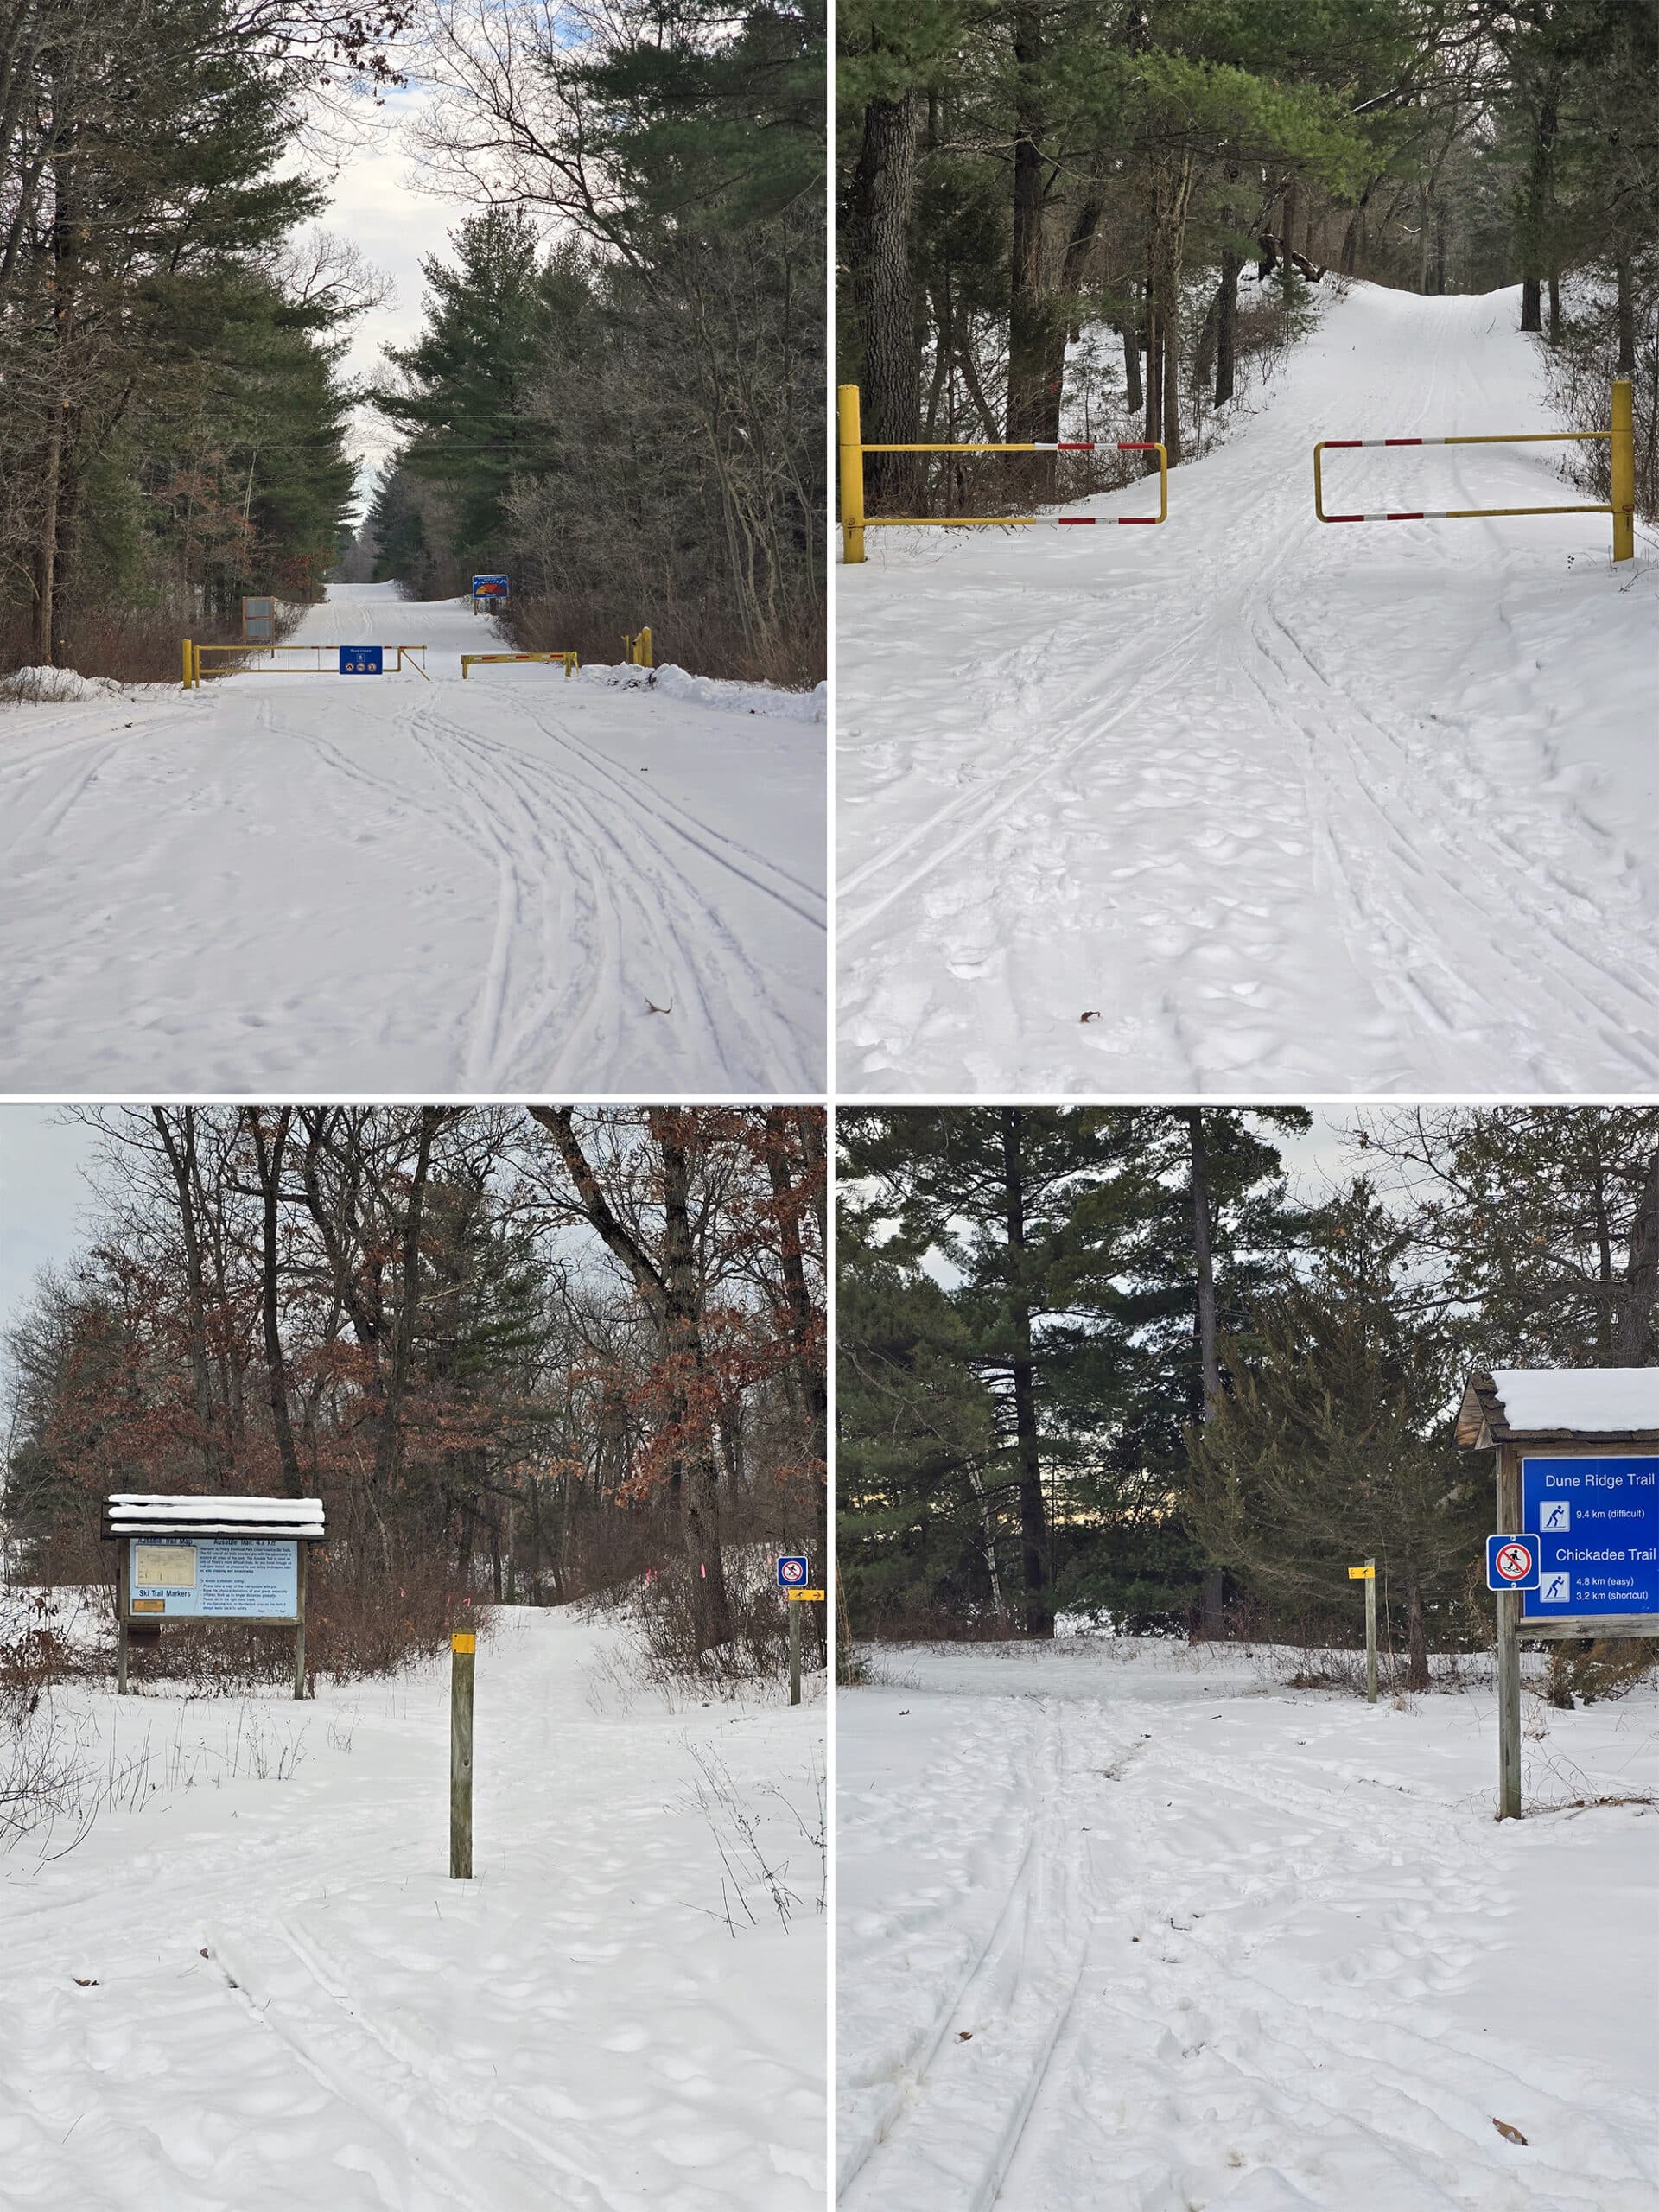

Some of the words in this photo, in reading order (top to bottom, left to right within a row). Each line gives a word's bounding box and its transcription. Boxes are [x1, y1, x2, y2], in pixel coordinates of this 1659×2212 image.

[1545, 1474, 1580, 1486] Dune
[1585, 1474, 1623, 1490] Ridge
[1626, 1473, 1655, 1486] Trail
[1576, 1510, 1590, 1519] 9.4
[1608, 1509, 1645, 1519] (difficult)
[1555, 1548, 1625, 1561] Chickadee
[1628, 1548, 1656, 1560] Trail
[1607, 1576, 1634, 1586] (easy)
[1576, 1592, 1590, 1600] 3.2
[1592, 1592, 1605, 1600] km
[1608, 1591, 1649, 1601] (shortcut)
